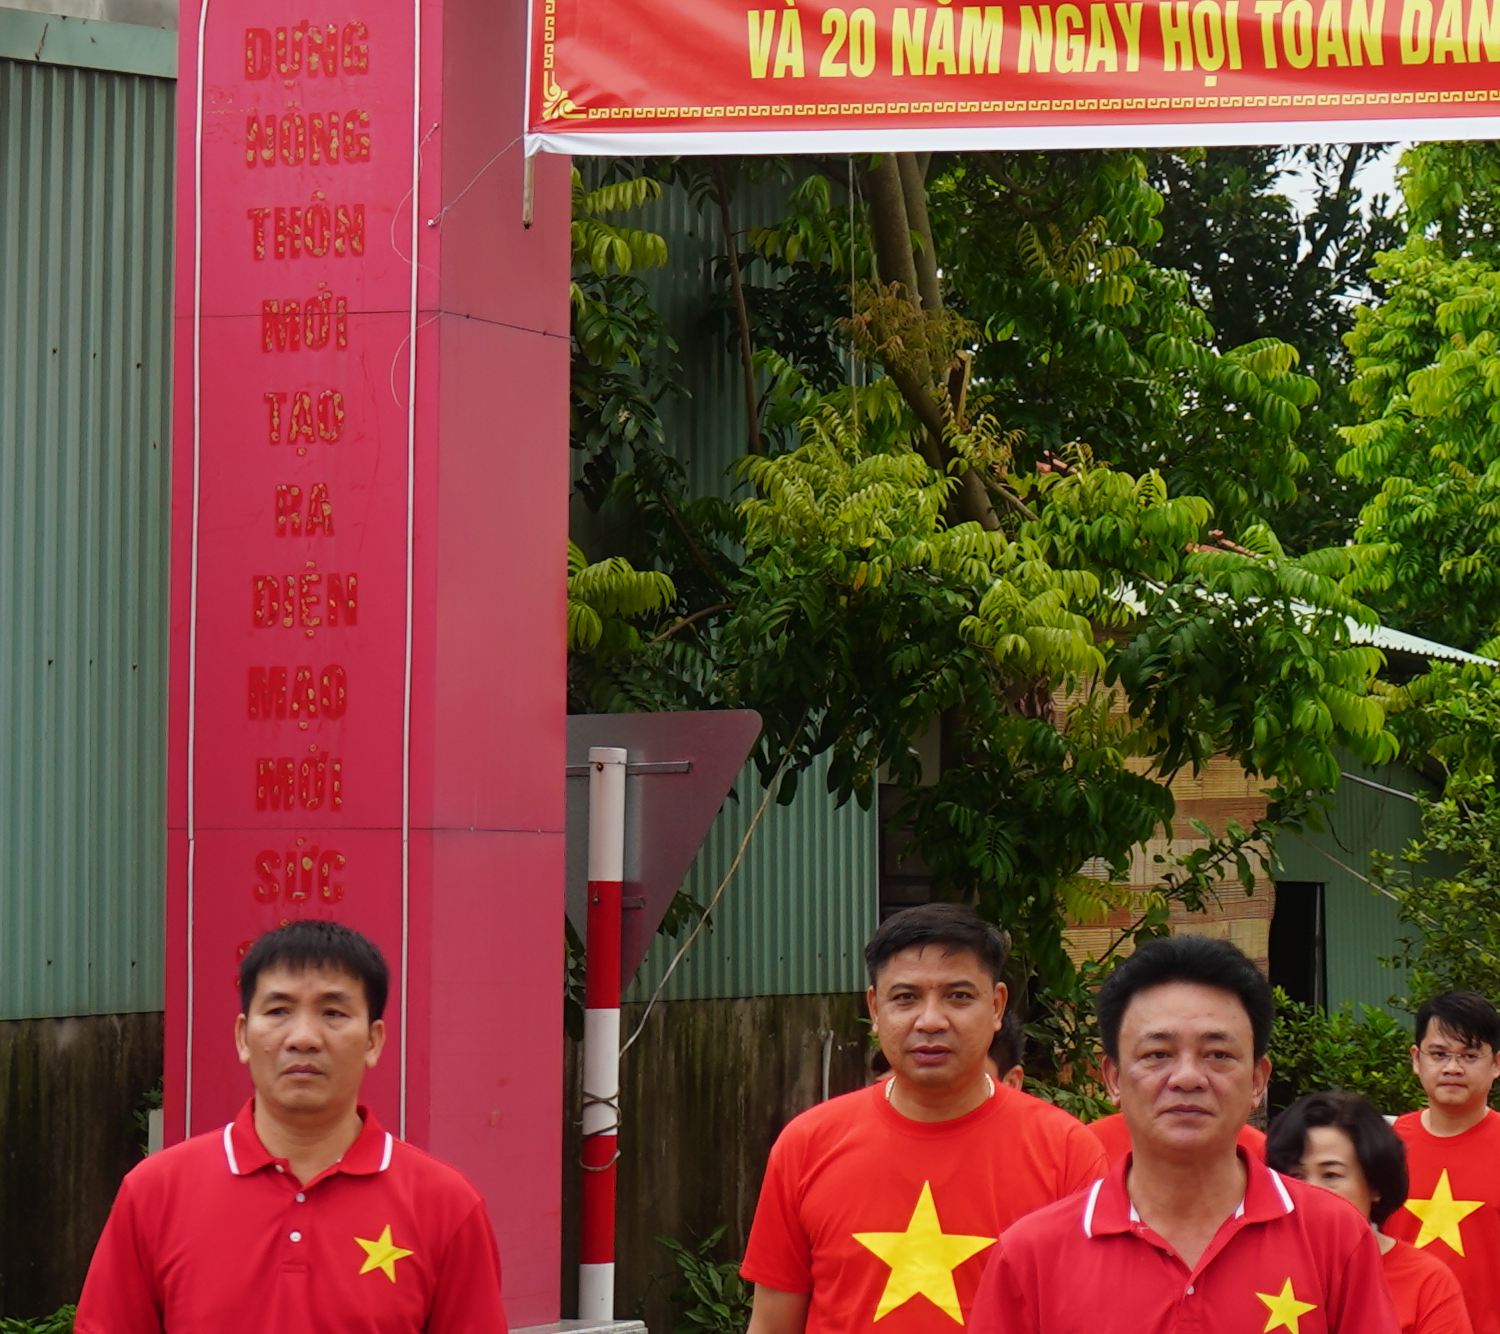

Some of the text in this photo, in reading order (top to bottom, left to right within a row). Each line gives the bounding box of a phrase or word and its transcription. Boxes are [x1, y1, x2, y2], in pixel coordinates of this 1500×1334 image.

[244, 19, 369, 89] DỰNG
[819, 7, 877, 79] 20
[246, 100, 370, 169] NÔNG
[247, 190, 365, 261] THÔN
[261, 282, 347, 352] MỚI
[263, 389, 345, 456] TẠO
[275, 482, 335, 537] RA
[252, 561, 358, 638] DIỆN
[248, 664, 348, 730] MẠO
[256, 744, 343, 812] MỚI
[253, 837, 347, 905] SỨC
